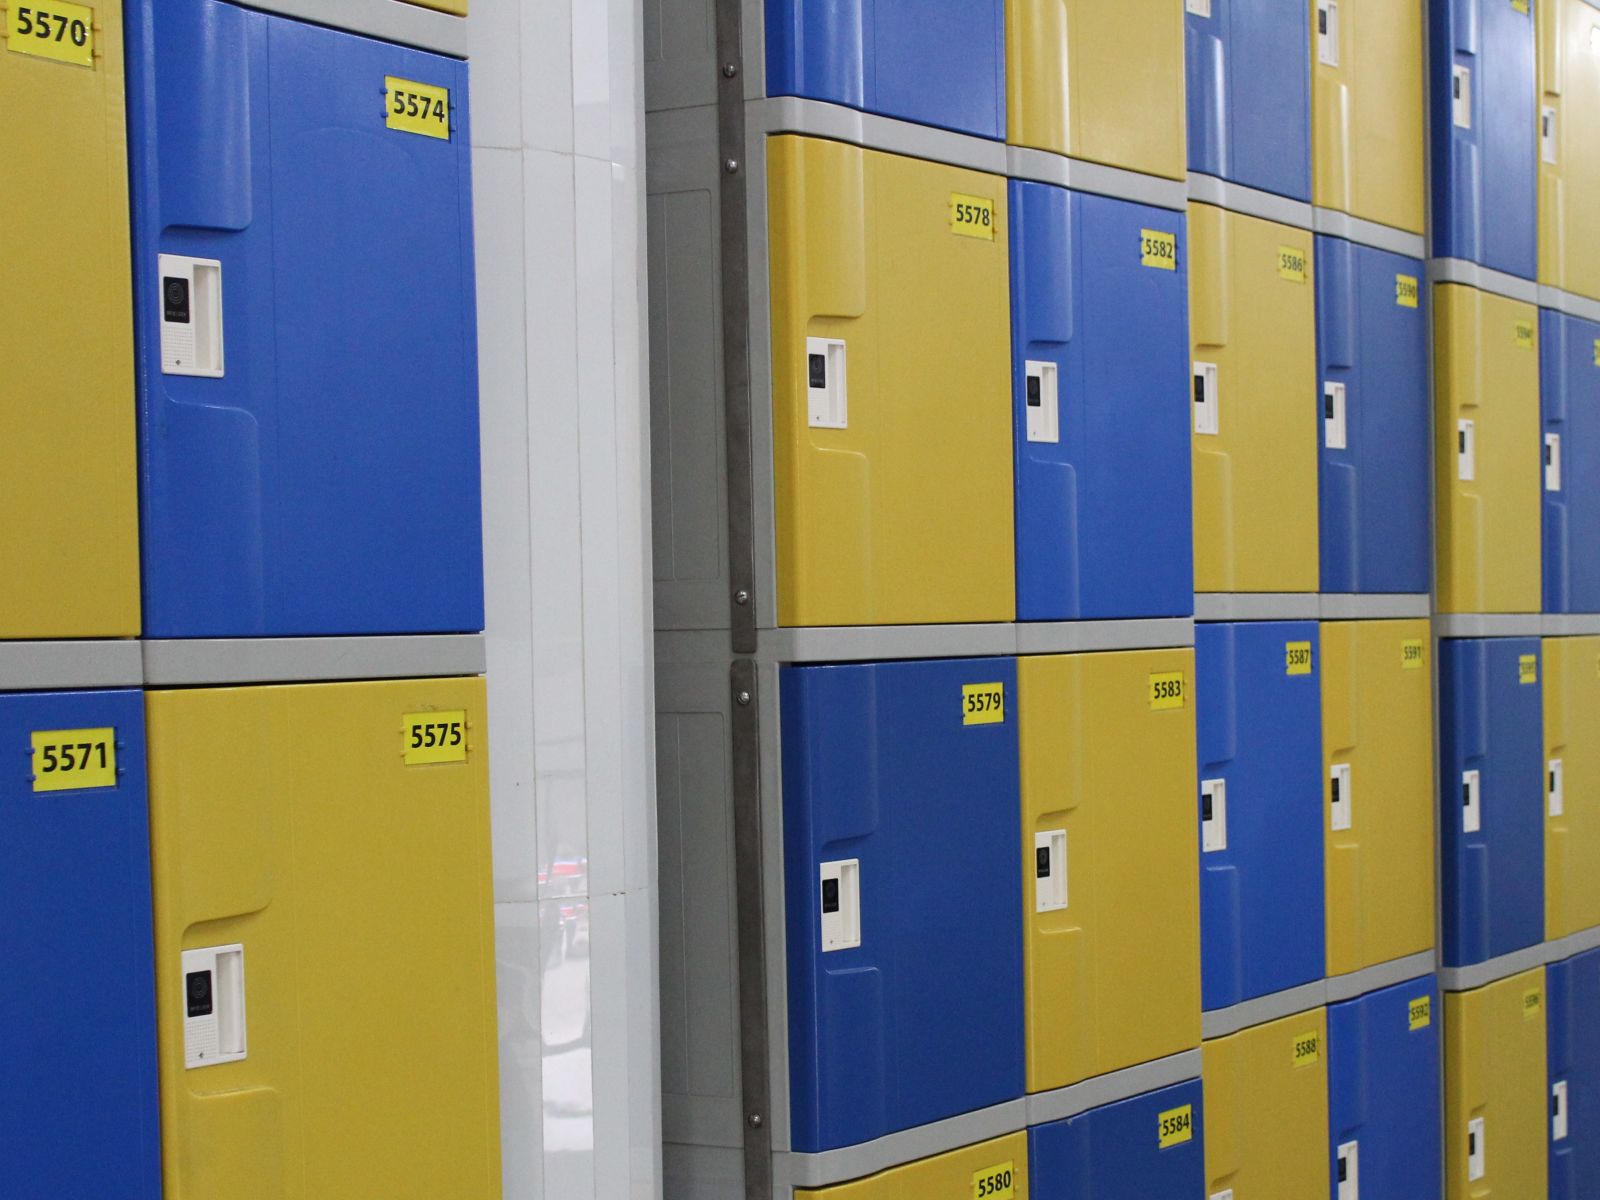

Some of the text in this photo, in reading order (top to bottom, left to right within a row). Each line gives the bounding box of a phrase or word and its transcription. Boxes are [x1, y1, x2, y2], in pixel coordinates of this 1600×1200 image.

[17, 7, 86, 47] 5570
[393, 90, 446, 124] 5574
[956, 205, 991, 228] 5578
[1145, 239, 1173, 260] 5582
[1281, 254, 1303, 272] 5586
[1289, 649, 1309, 665] 5587
[1154, 680, 1181, 699] 5583
[967, 692, 1001, 713] 5579
[411, 723, 462, 749] 5575
[42, 742, 108, 773] 5571
[1295, 1039, 1316, 1058] 5588
[1162, 1112, 1190, 1136] 5584
[978, 1170, 1011, 1198] 5580
